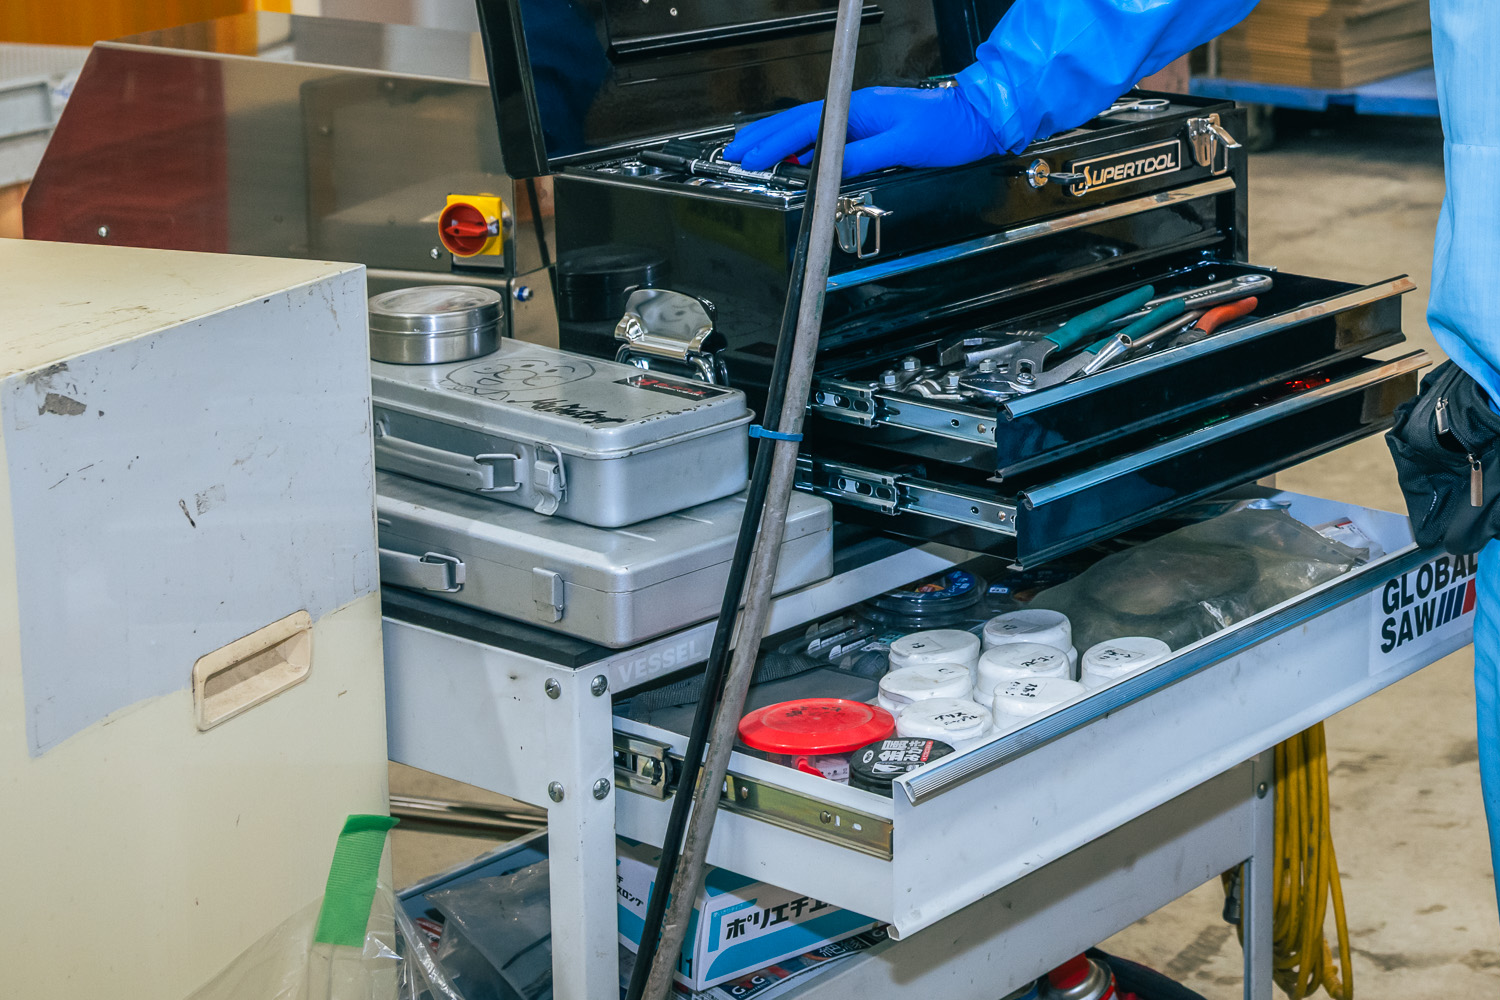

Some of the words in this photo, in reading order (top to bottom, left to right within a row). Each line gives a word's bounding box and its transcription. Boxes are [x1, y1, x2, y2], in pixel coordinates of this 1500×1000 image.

[1079, 153, 1176, 189] SUPERTOOL
[618, 641, 701, 683] VESSEL
[878, 740, 910, 762] 金属
[903, 740, 927, 762] みがき
